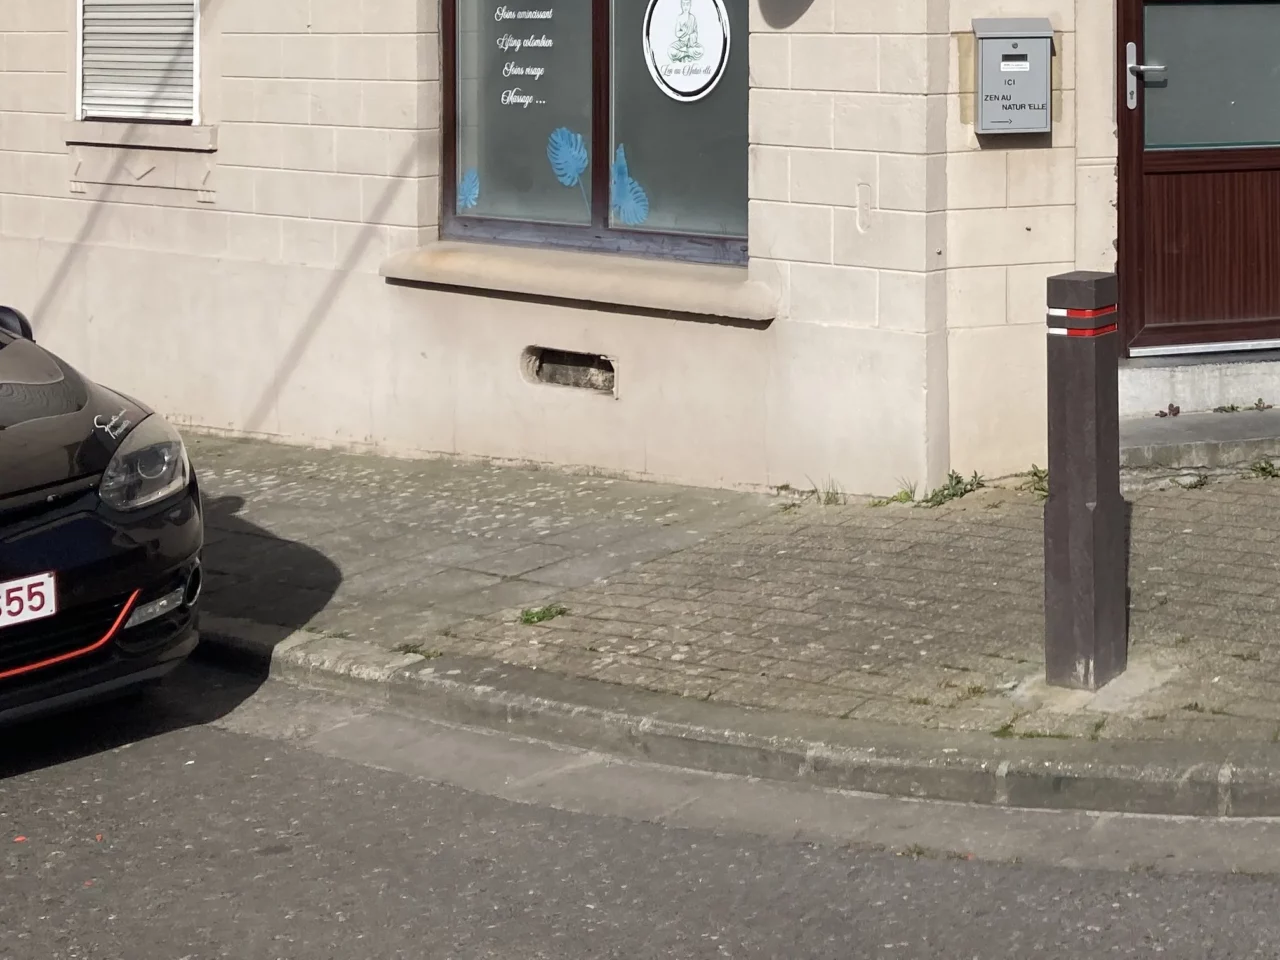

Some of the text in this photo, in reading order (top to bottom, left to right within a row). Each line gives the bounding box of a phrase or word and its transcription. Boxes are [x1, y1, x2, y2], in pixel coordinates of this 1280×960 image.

[984, 94, 1012, 102] ZEN AU
[0, 581, 45, 619] 55
